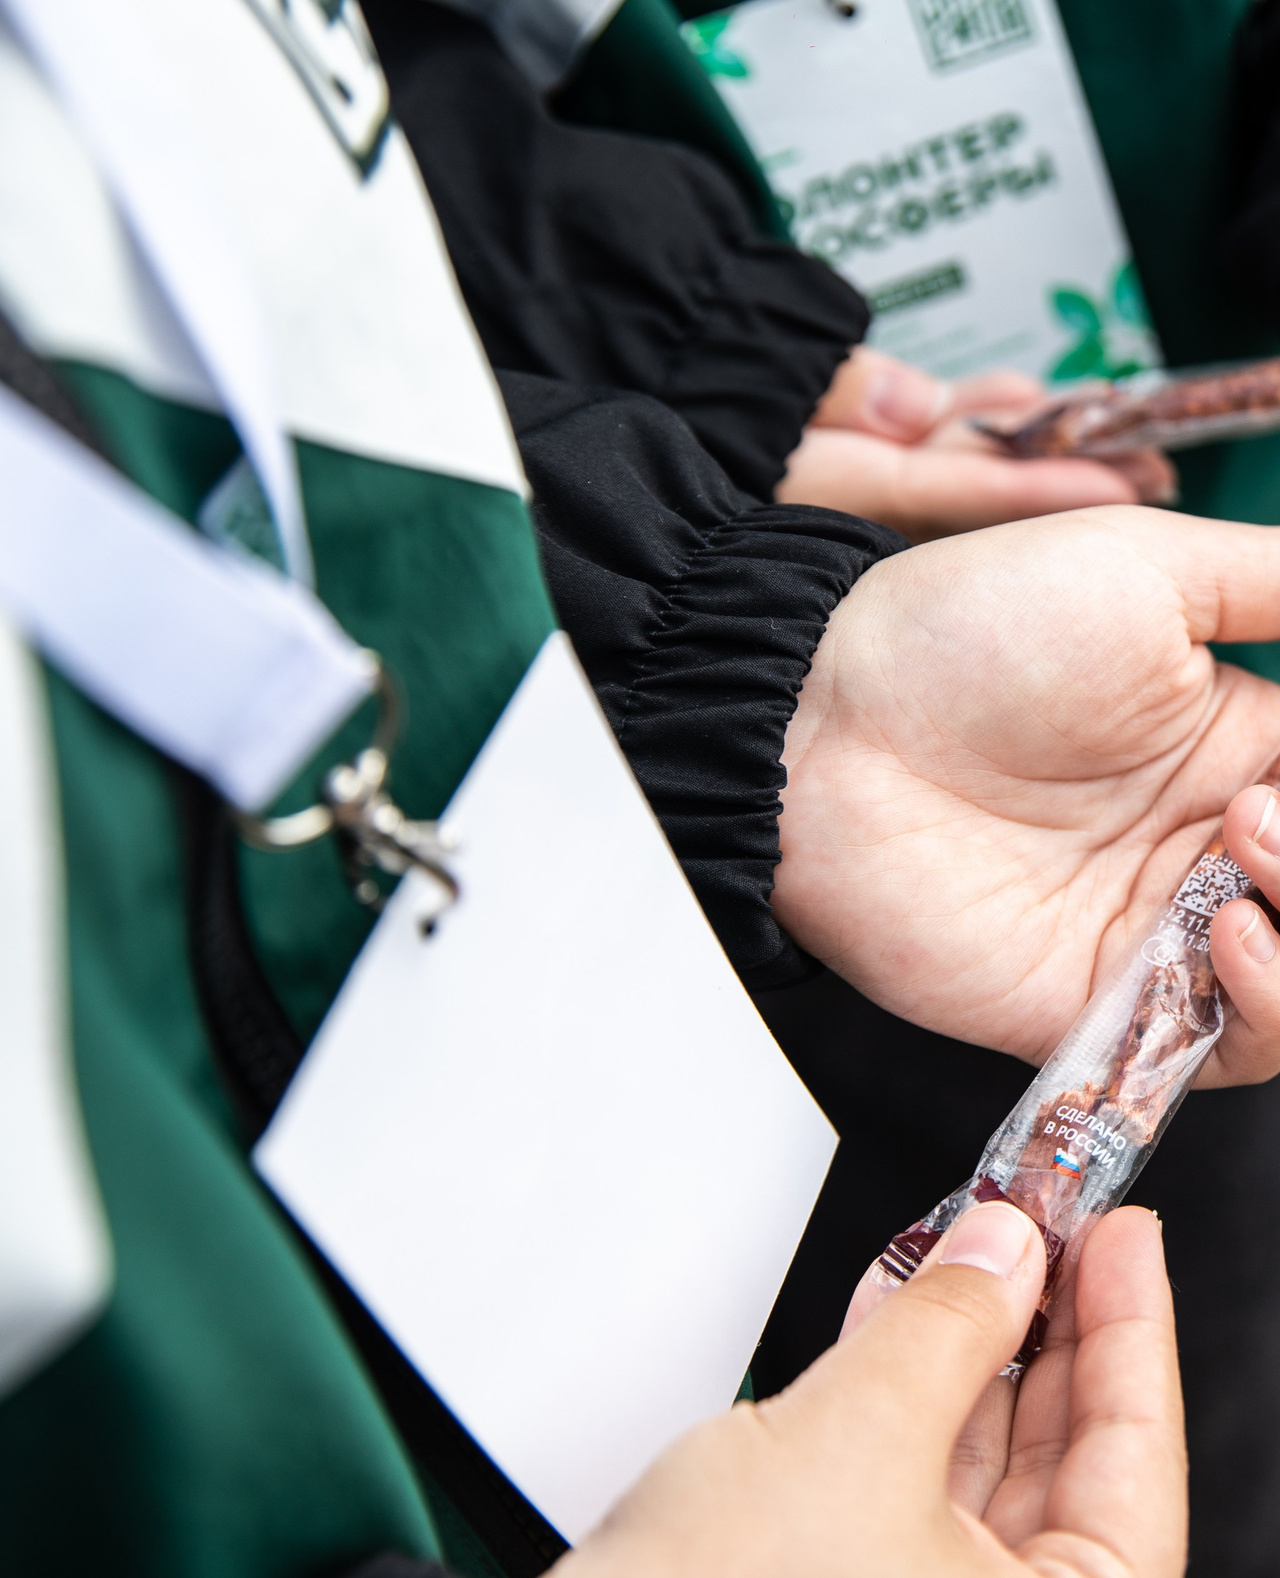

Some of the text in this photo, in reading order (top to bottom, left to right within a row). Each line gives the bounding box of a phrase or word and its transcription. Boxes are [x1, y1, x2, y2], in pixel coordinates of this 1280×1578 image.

[1043, 1121, 1117, 1170] В РОССИИ
[1056, 1105, 1127, 1151] СДЕЛАНО
